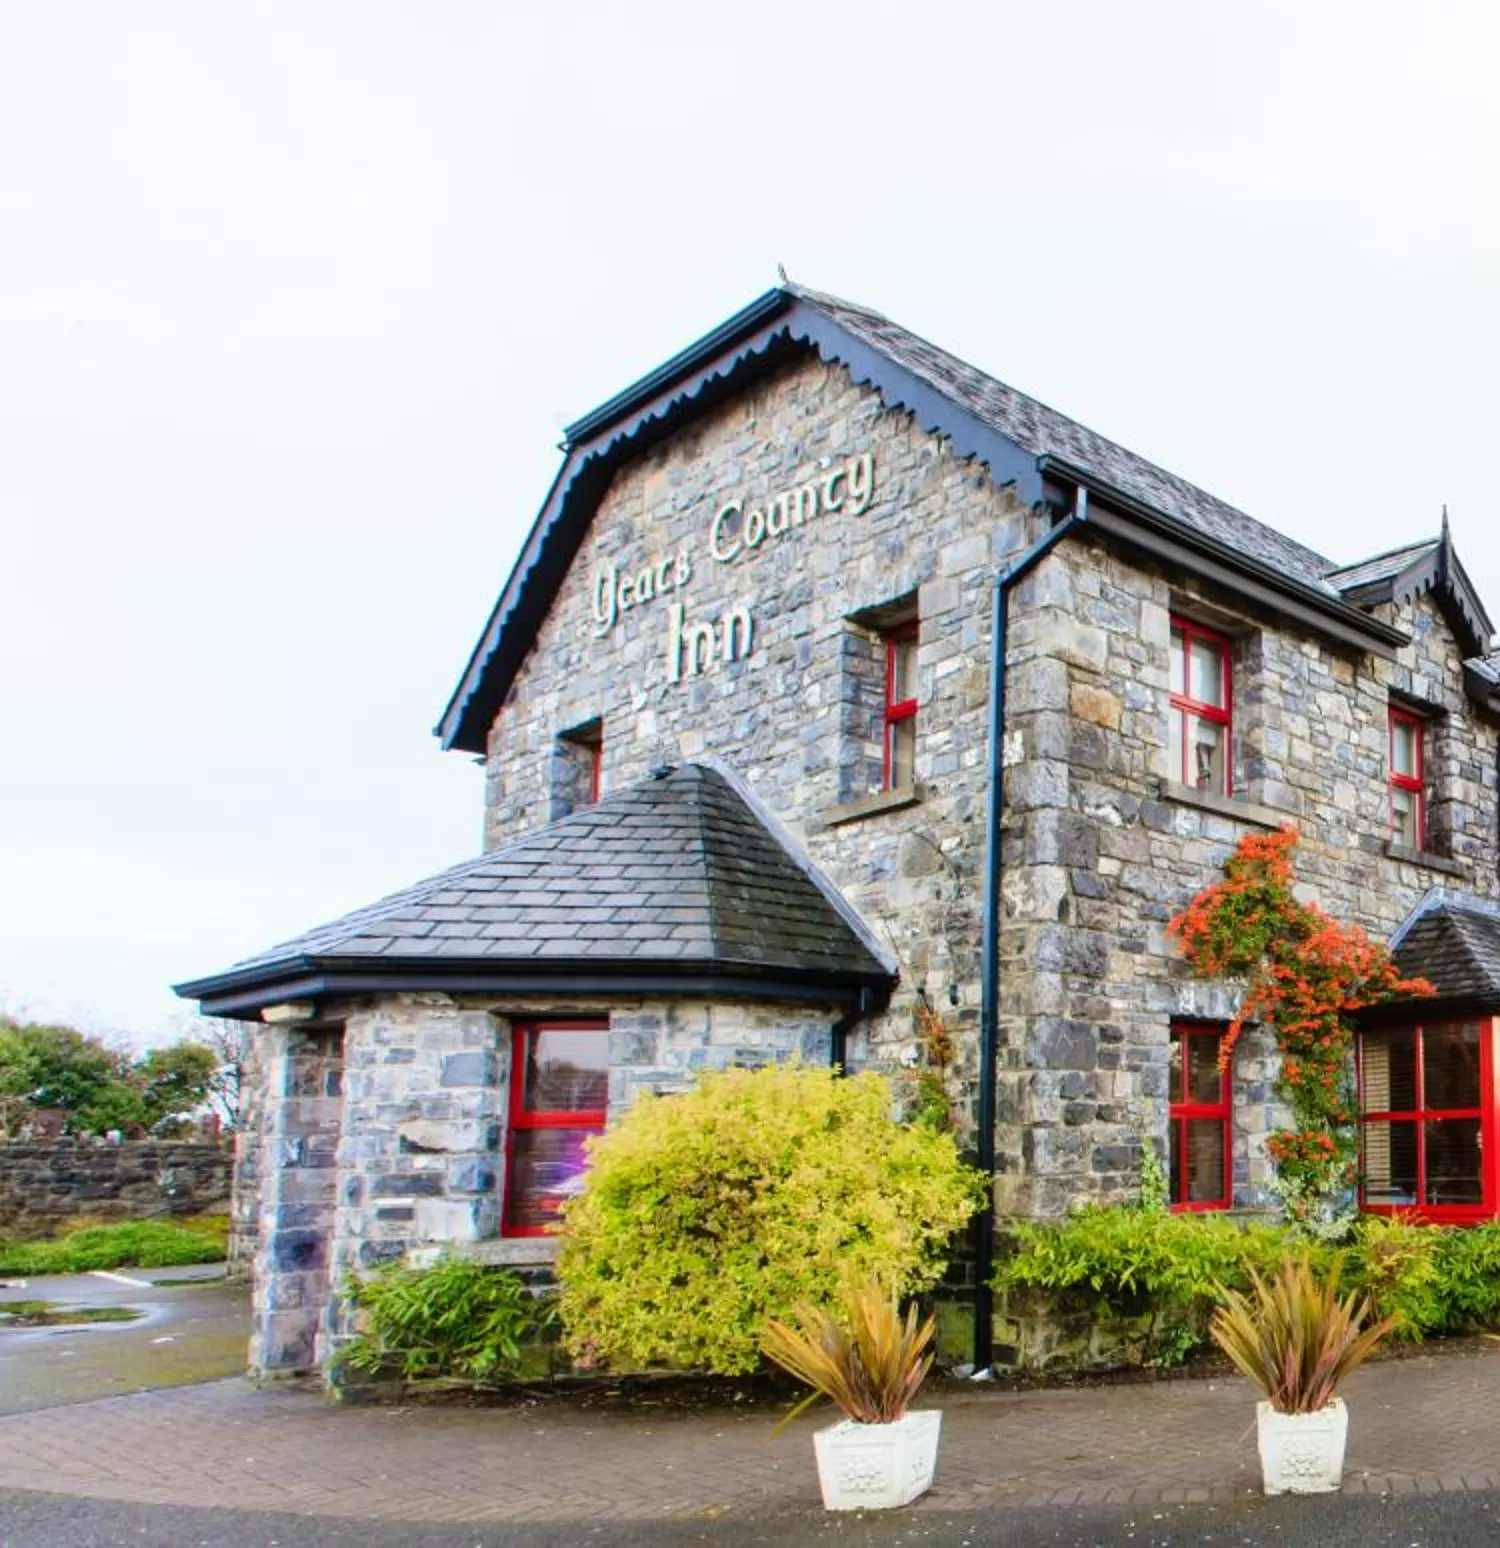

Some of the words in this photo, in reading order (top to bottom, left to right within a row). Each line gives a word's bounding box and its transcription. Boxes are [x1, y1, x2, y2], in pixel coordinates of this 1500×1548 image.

[593, 551, 692, 638] Yeats
[711, 453, 874, 562] County
[668, 602, 754, 684] Inn
